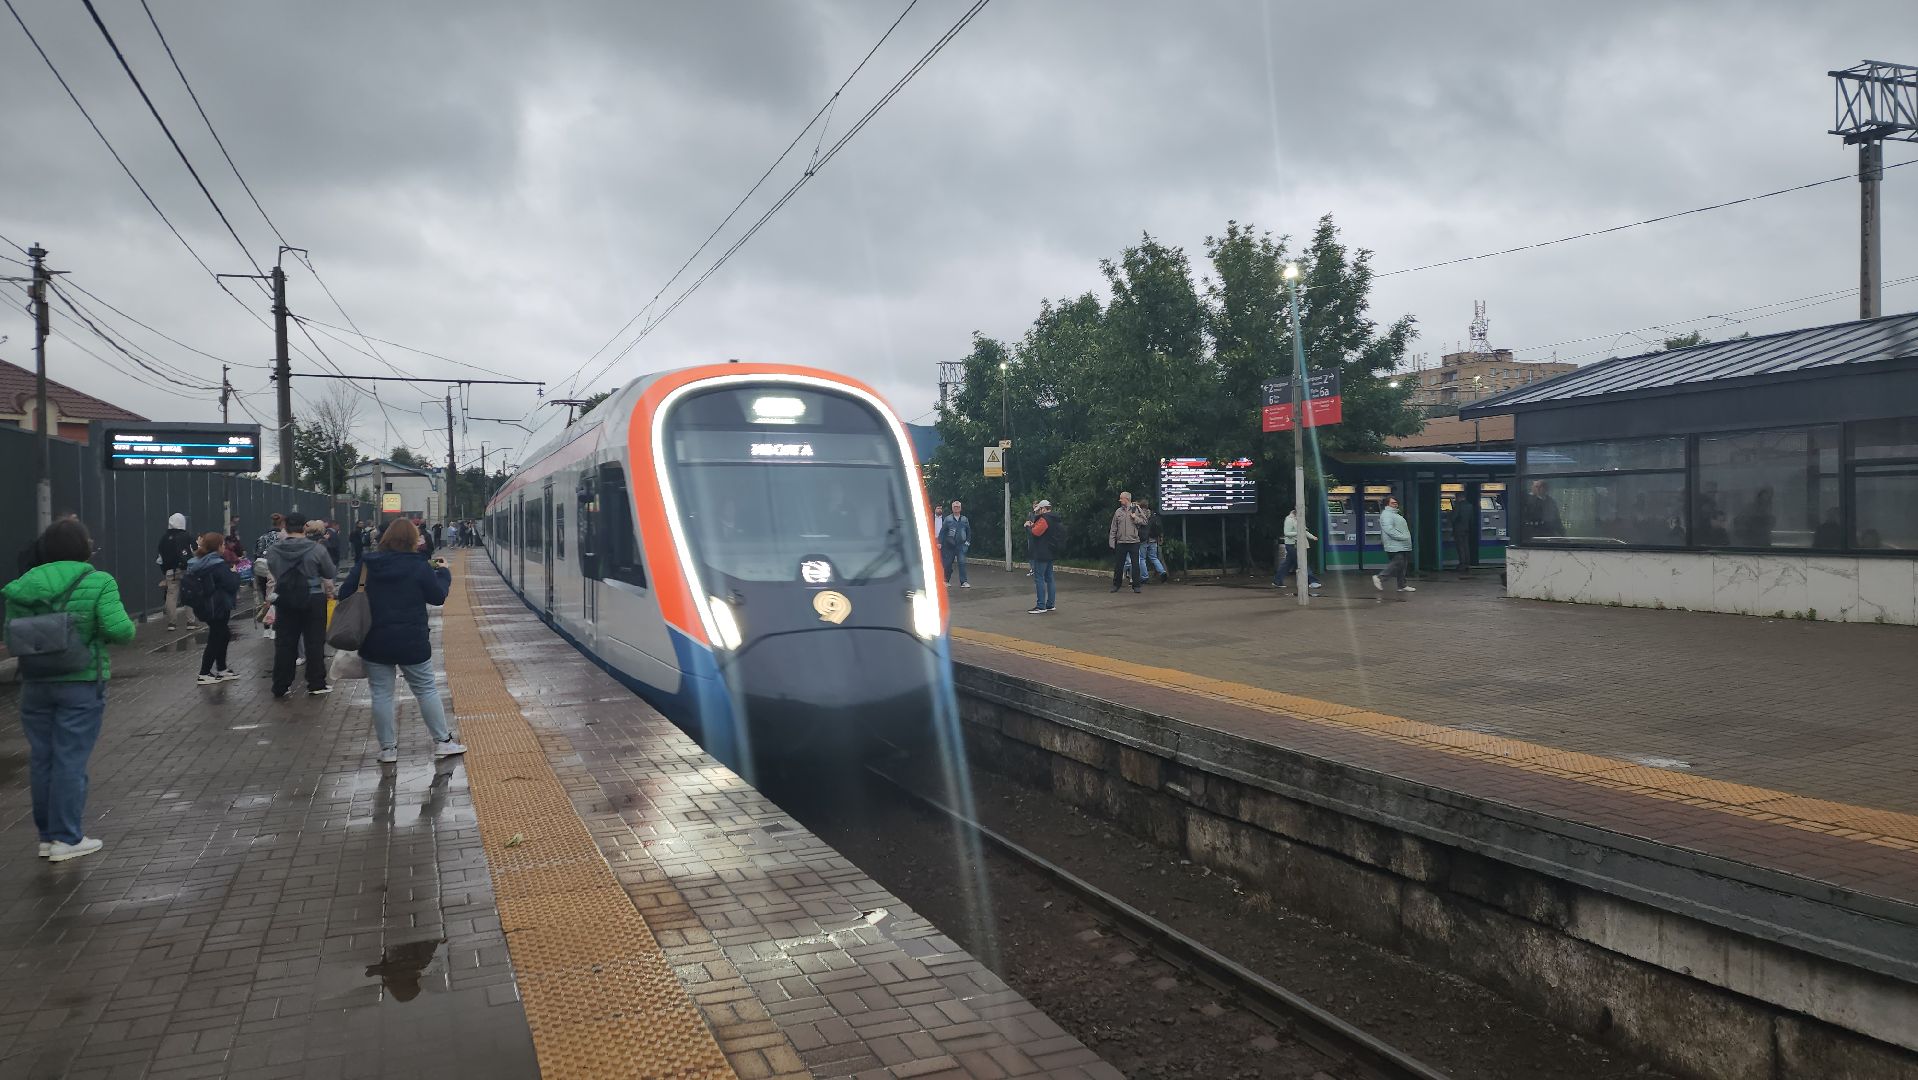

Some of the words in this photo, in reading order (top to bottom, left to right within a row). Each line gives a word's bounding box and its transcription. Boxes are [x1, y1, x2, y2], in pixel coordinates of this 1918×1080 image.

[1322, 374, 1329, 384] 2
[1269, 384, 1274, 393] 2
[1269, 395, 1274, 405] 6
